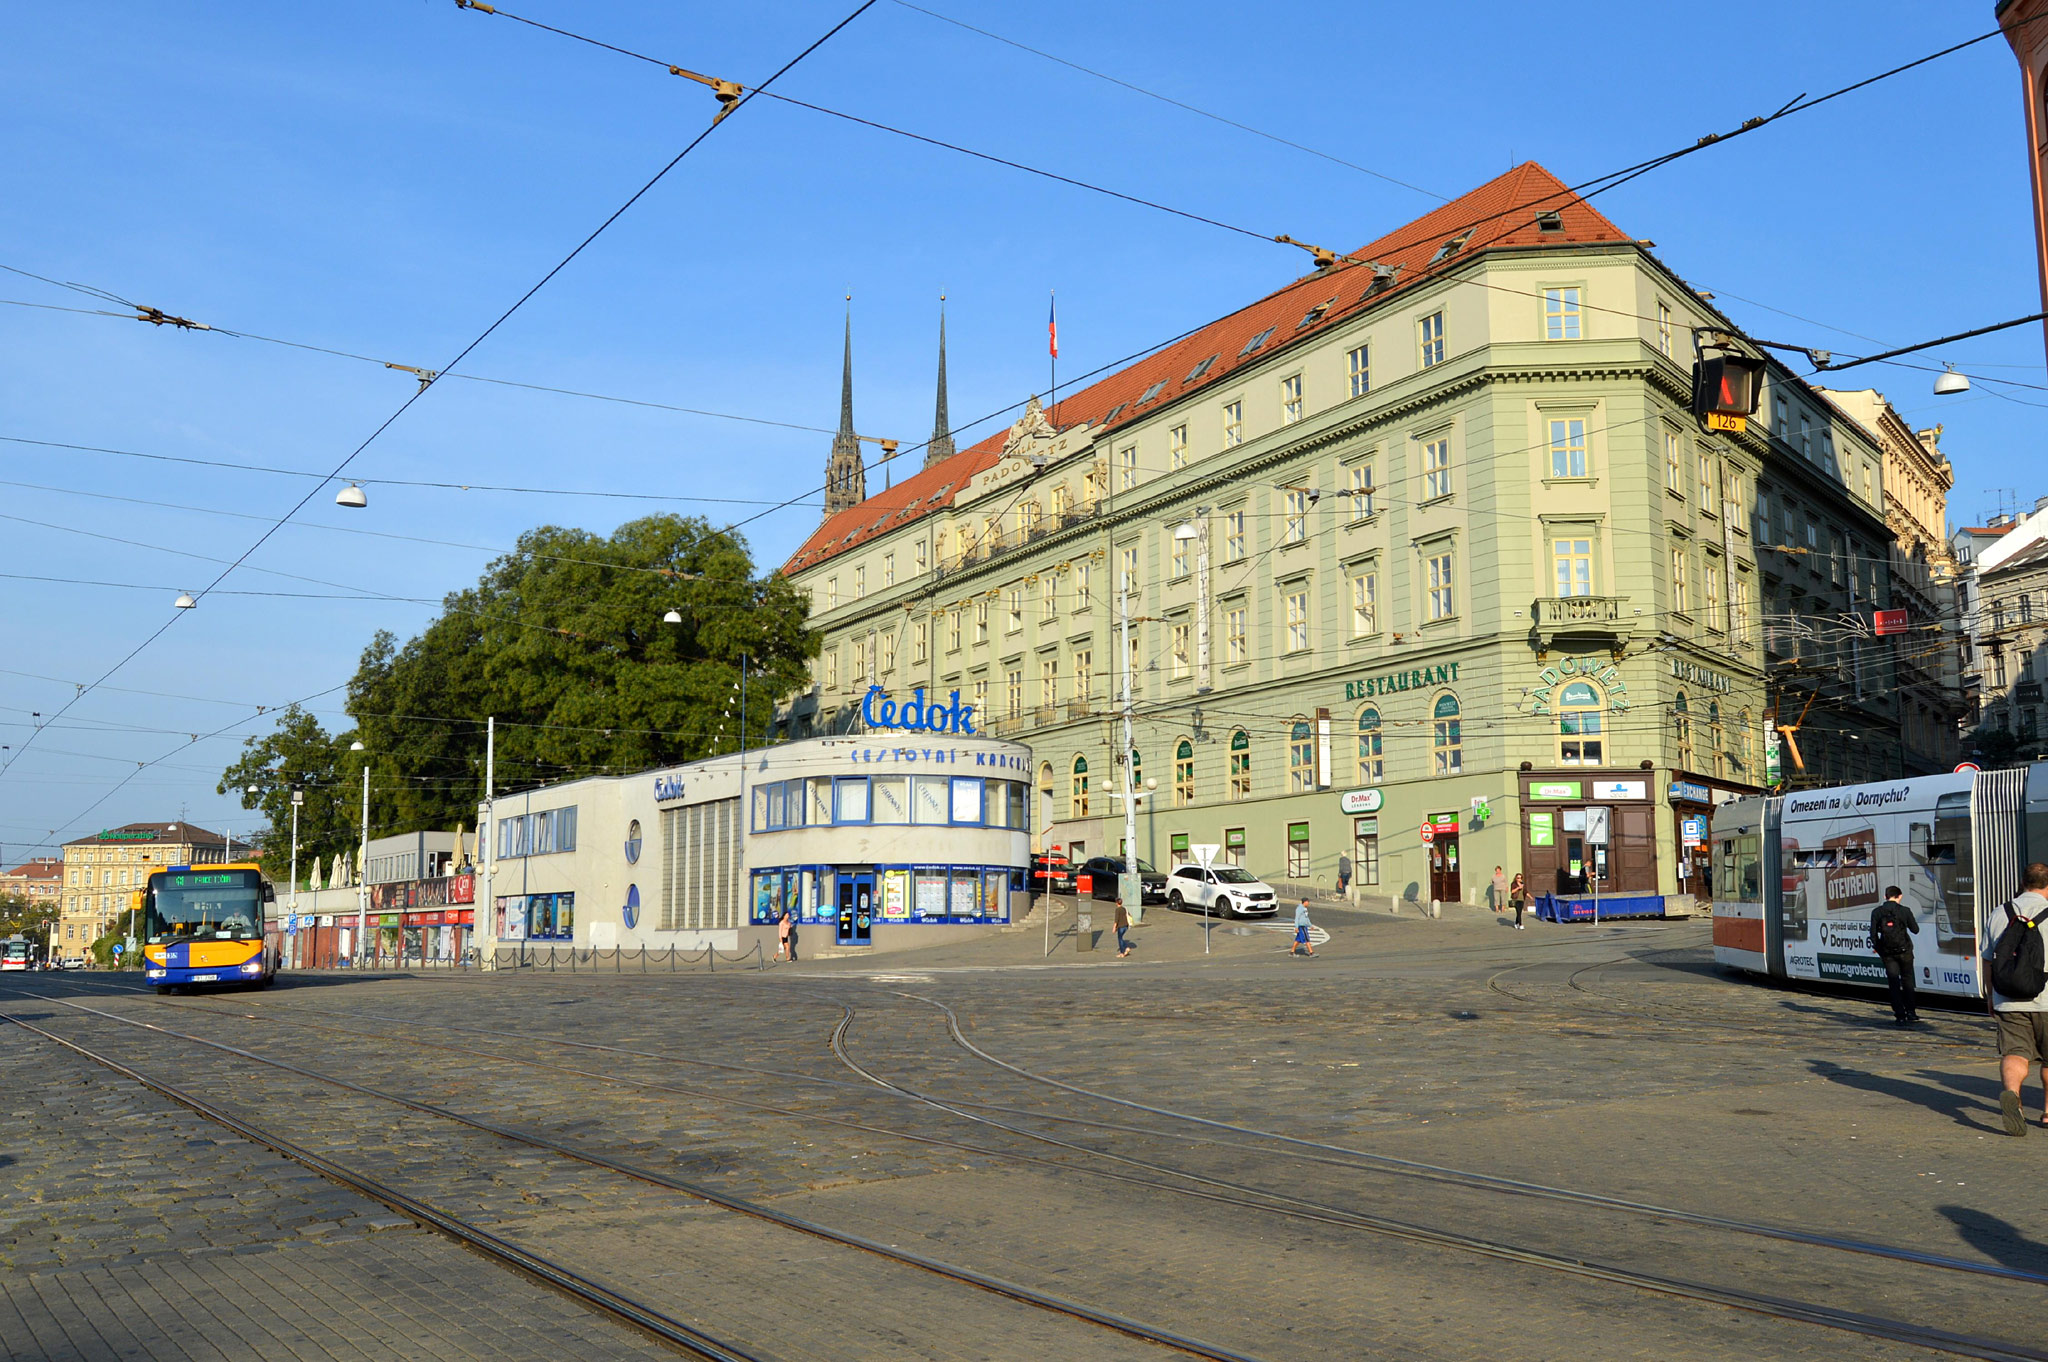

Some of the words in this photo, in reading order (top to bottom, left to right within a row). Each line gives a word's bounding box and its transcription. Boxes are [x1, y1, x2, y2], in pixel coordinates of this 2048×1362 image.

[1715, 415, 1737, 430] 126
[1345, 662, 1461, 702] RESTAURANT
[1672, 658, 1731, 694] RESTAURANT
[862, 684, 976, 734] Čedok
[851, 747, 957, 764] CESTOVNÍ
[1351, 794, 1370, 803] Dr.Max
[1790, 795, 1829, 813] Omezení
[1829, 798, 1841, 810] na
[1856, 786, 1910, 807] Dornychu?
[1827, 871, 1877, 901] OTEVŘENO
[1859, 923, 1871, 933] Kalo
[1830, 934, 1864, 951] Dornych
[1790, 955, 1815, 967] AGROTEC
[1821, 961, 1889, 979] www.agrotectruc
[1944, 971, 1971, 985] IVECO
